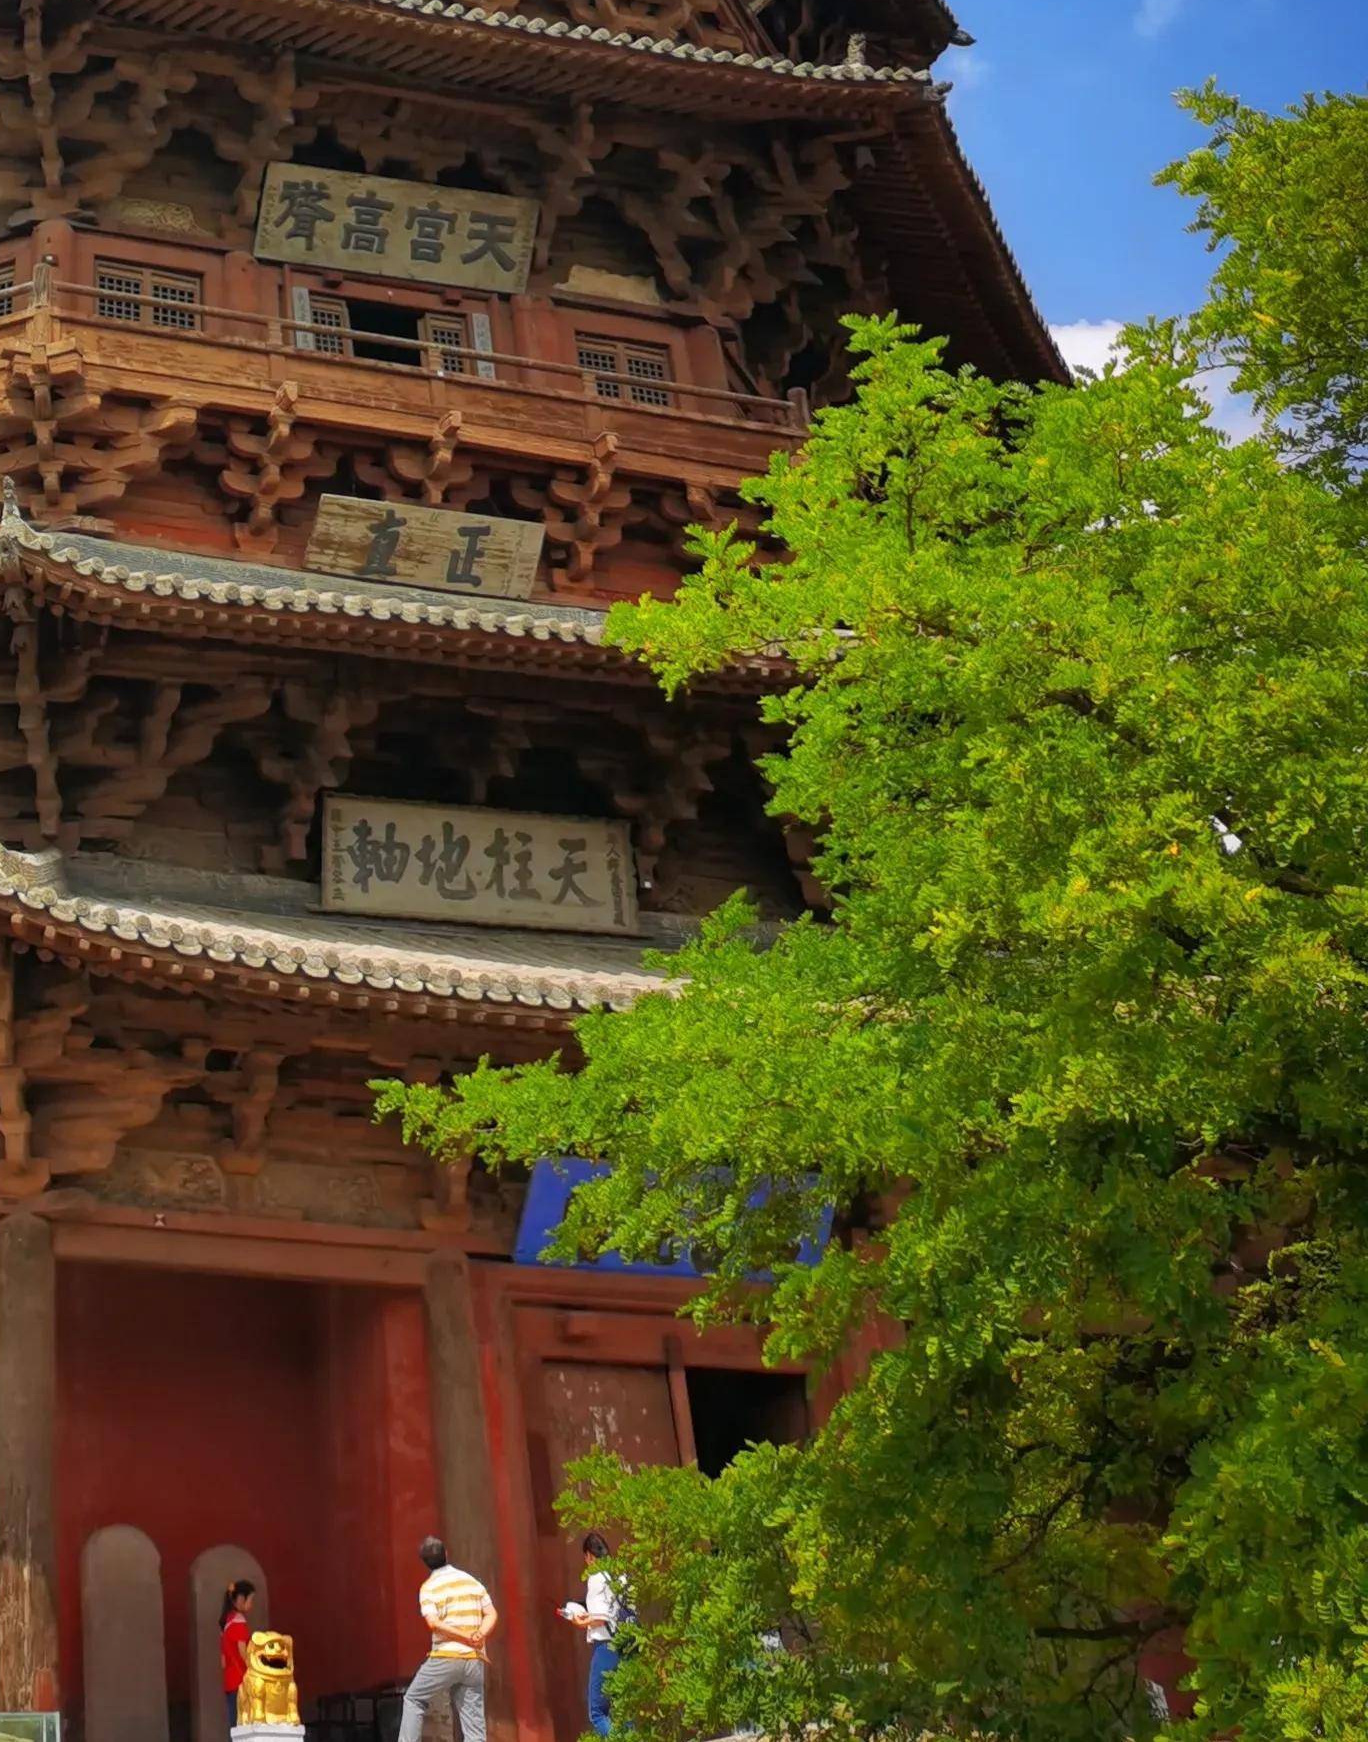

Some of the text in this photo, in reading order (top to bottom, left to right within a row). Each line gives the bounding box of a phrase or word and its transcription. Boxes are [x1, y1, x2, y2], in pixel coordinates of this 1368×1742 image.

[357, 508, 492, 588] 正直
[346, 818, 606, 908] 天柱地軸
